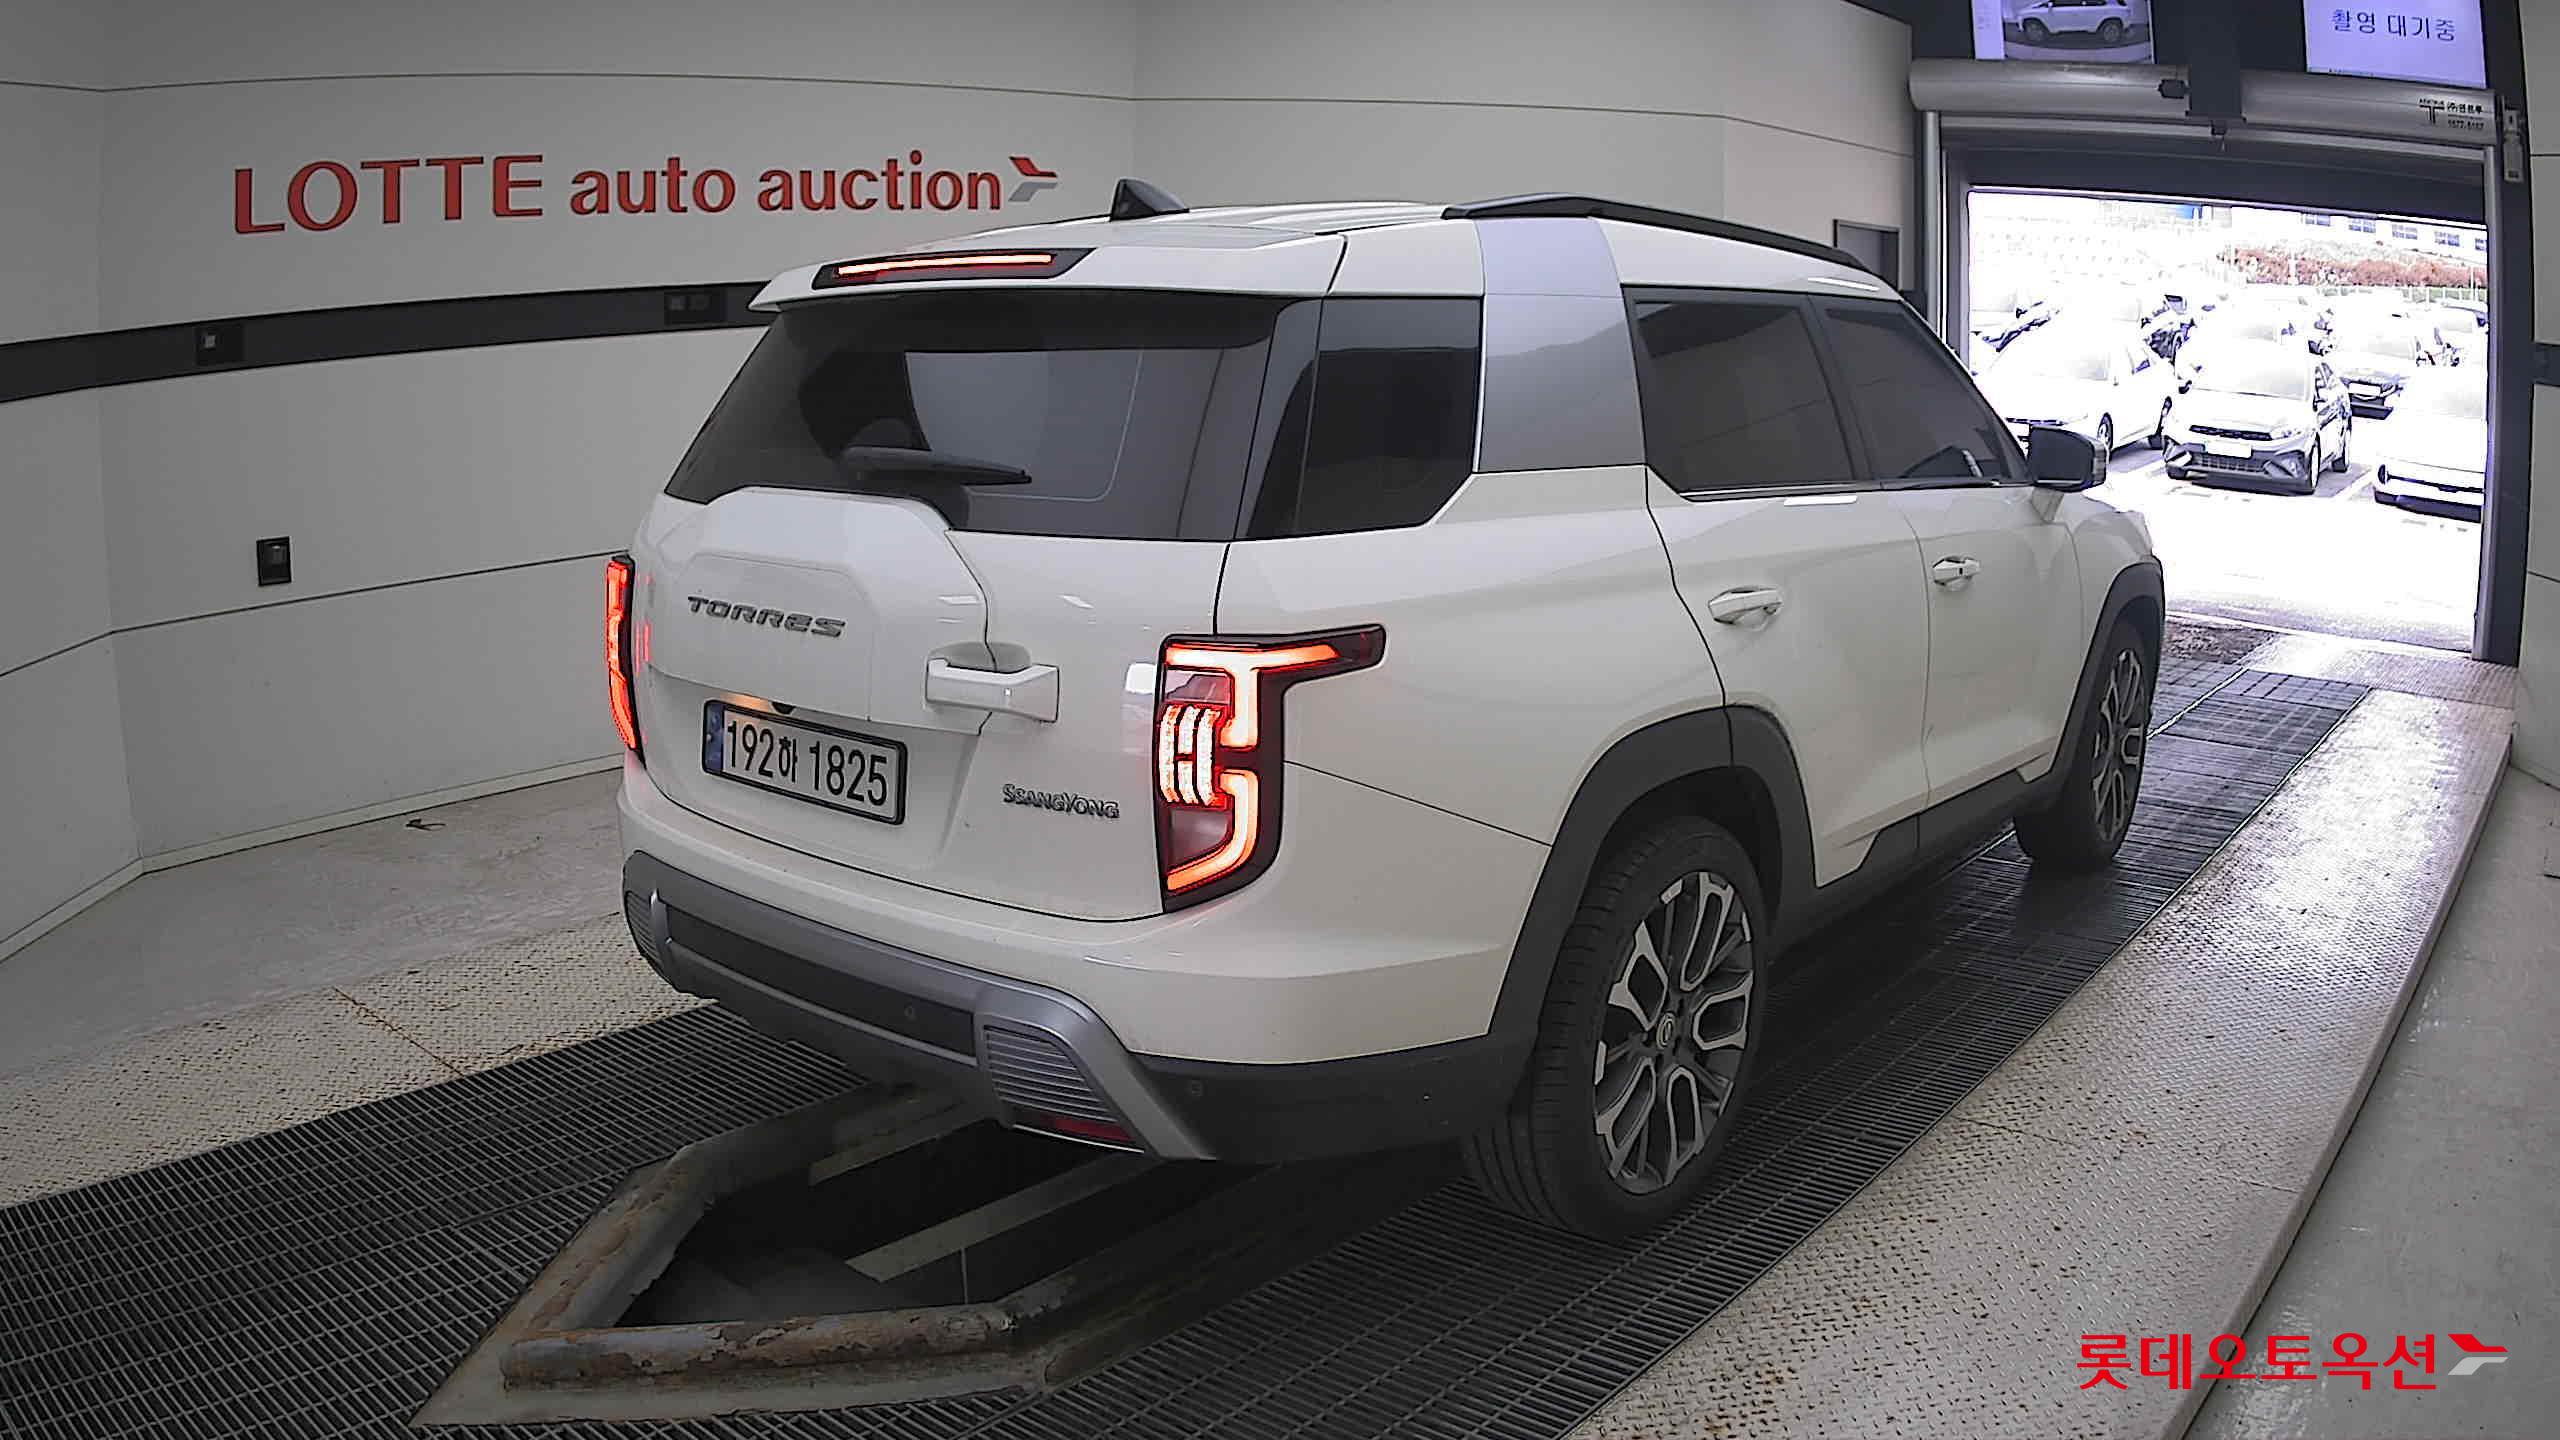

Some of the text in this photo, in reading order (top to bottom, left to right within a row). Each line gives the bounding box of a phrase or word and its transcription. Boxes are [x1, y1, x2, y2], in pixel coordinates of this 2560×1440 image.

[2332, 9, 2456, 42] 촬영 대기중
[235, 150, 1001, 234] LOTTE auto auction
[688, 596, 846, 638] TORRES
[727, 720, 888, 806] 192하 1825
